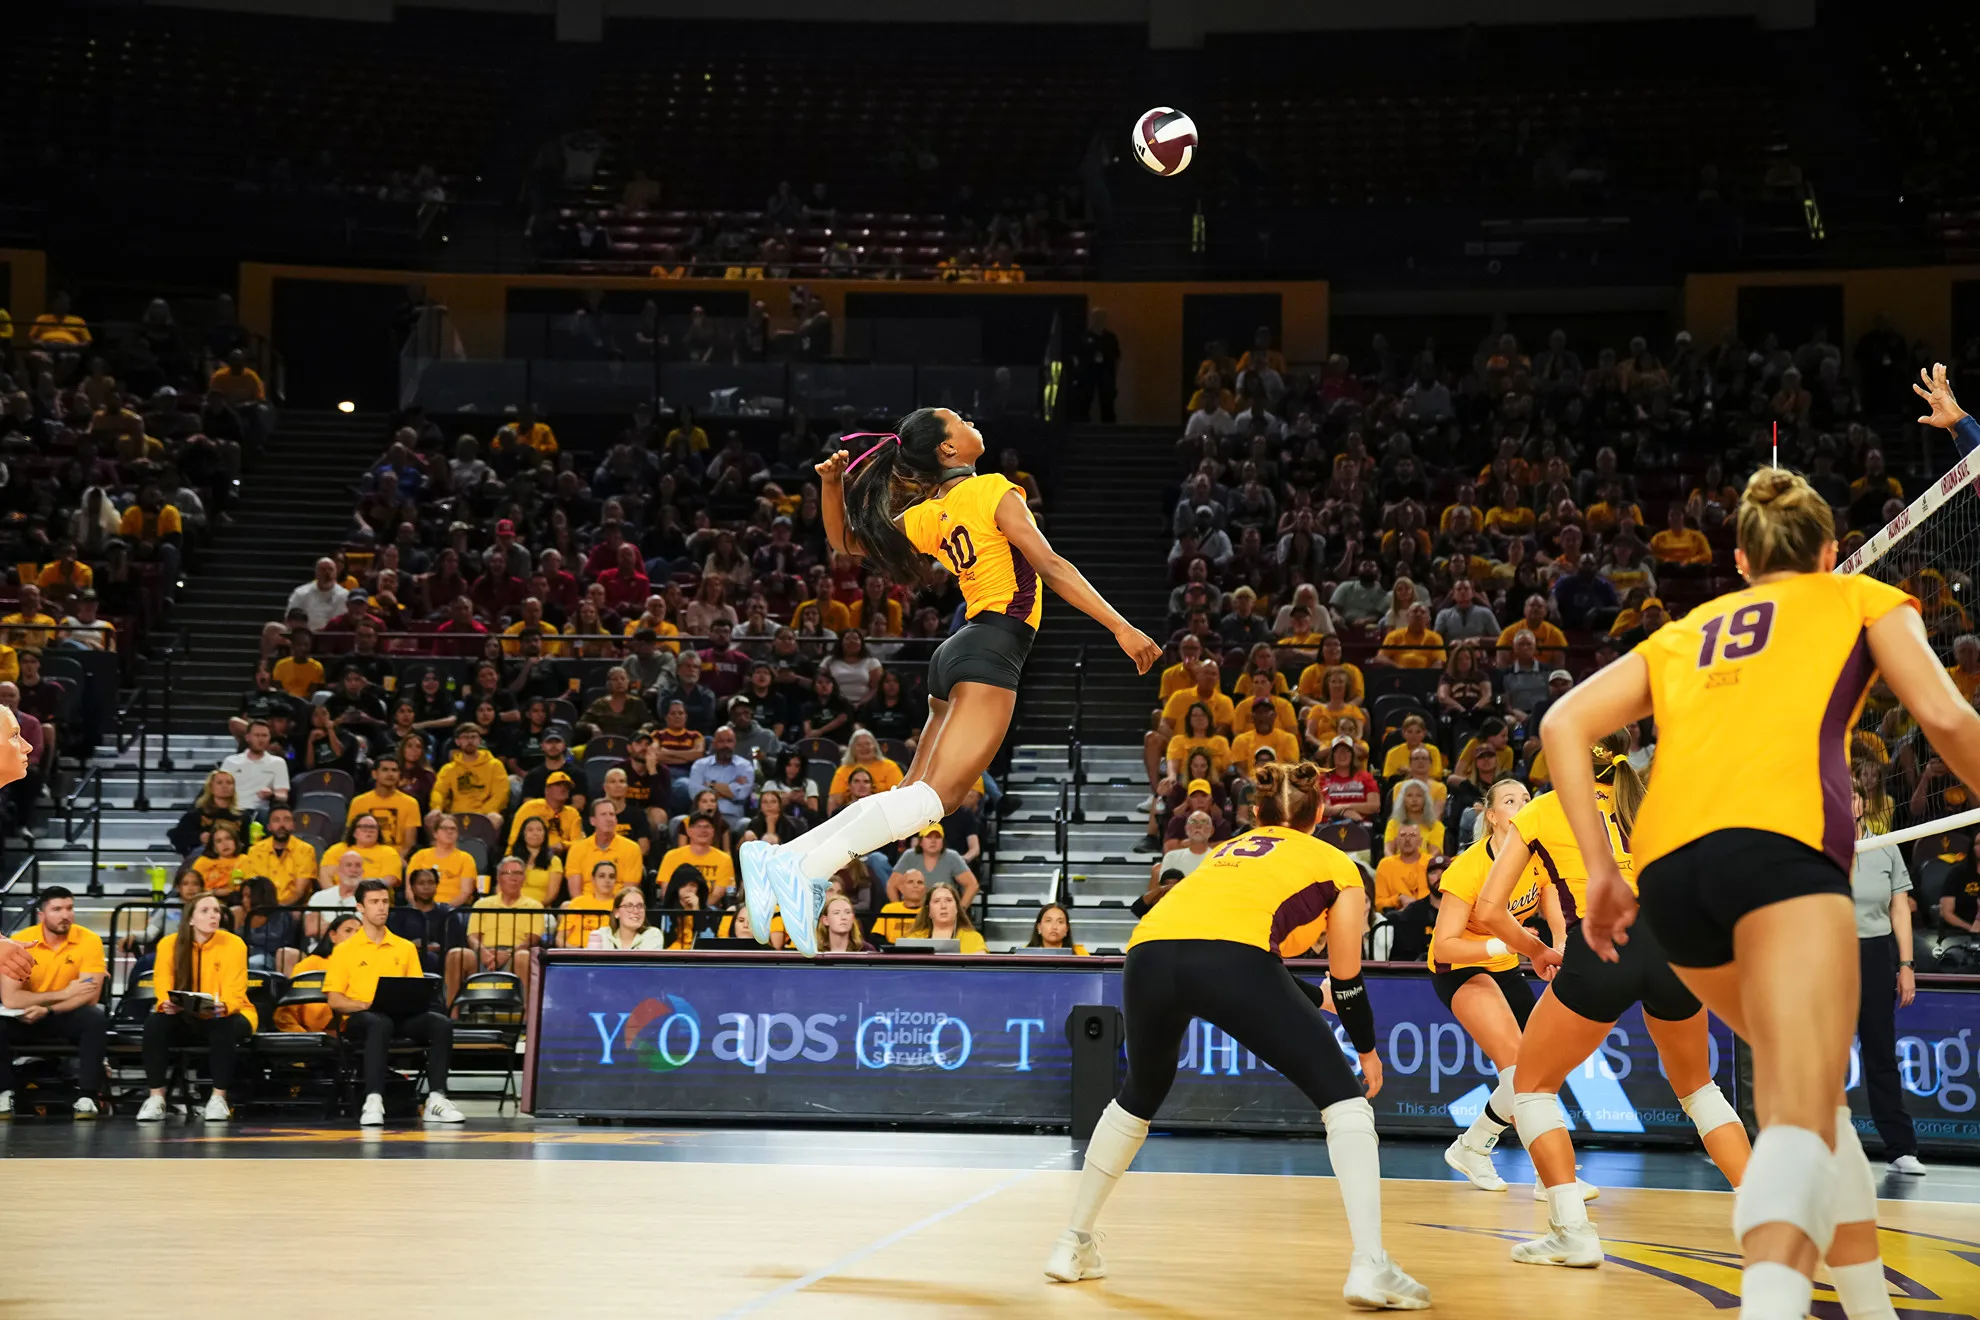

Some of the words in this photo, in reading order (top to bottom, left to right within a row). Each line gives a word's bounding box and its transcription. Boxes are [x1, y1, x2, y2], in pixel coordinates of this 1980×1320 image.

[940, 525, 977, 574] 10
[1698, 601, 1775, 668] 19
[1213, 836, 1285, 858] 13
[712, 1012, 838, 1074] aps
[1396, 1102, 1424, 1115] This
[1429, 1103, 1447, 1115] ad
[1451, 1104, 1477, 1116] and
[1569, 1110, 1591, 1120] are
[1595, 1107, 1681, 1122] shareholder
